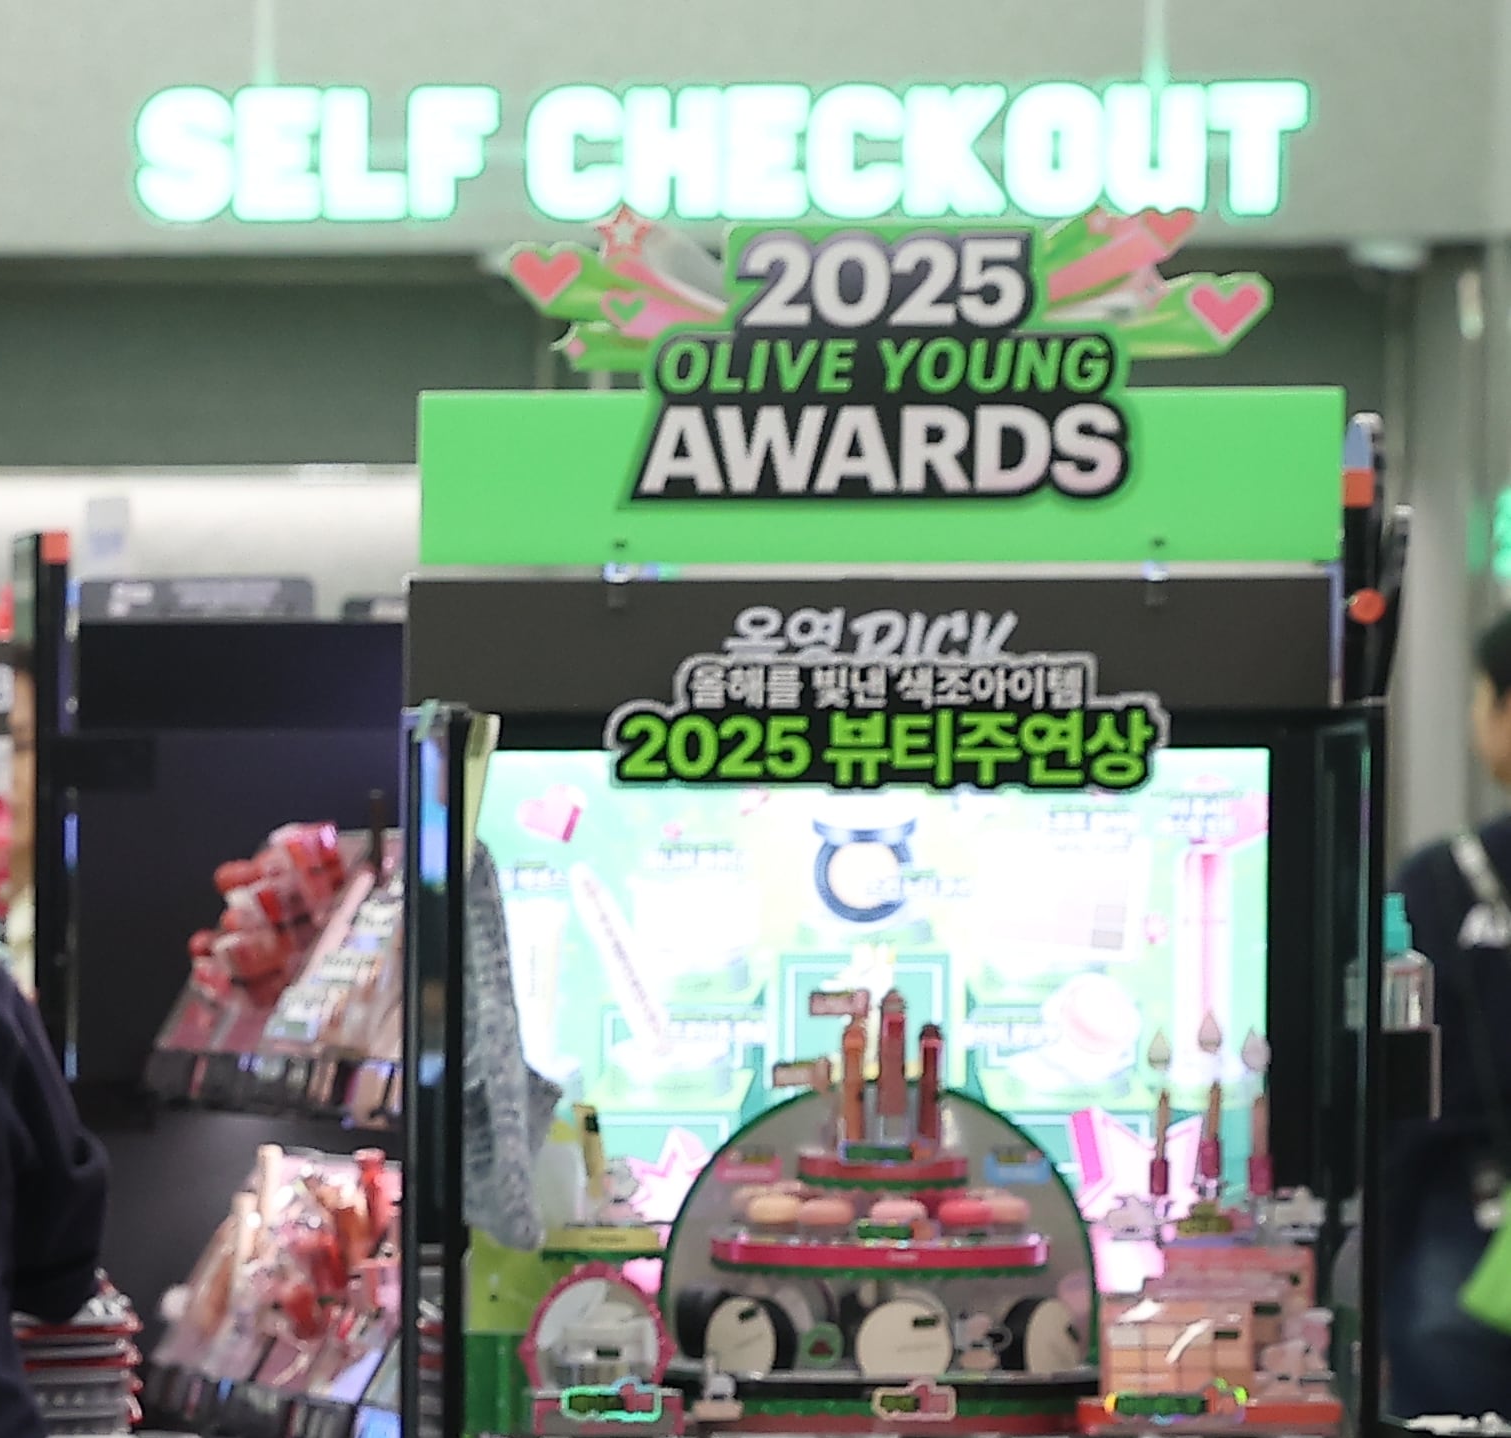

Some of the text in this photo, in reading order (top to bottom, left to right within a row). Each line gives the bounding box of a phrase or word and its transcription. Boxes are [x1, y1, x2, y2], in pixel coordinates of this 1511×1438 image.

[135, 81, 1309, 223] SELF CHECKOUT
[735, 238, 1030, 328] 2025
[658, 337, 1112, 396] OLIVE YOUNG
[637, 405, 1126, 496] AWARDS
[690, 664, 802, 709] 올해를
[896, 664, 1083, 709] 색조아이템
[620, 709, 1153, 784] 2025 뷰티주연상
